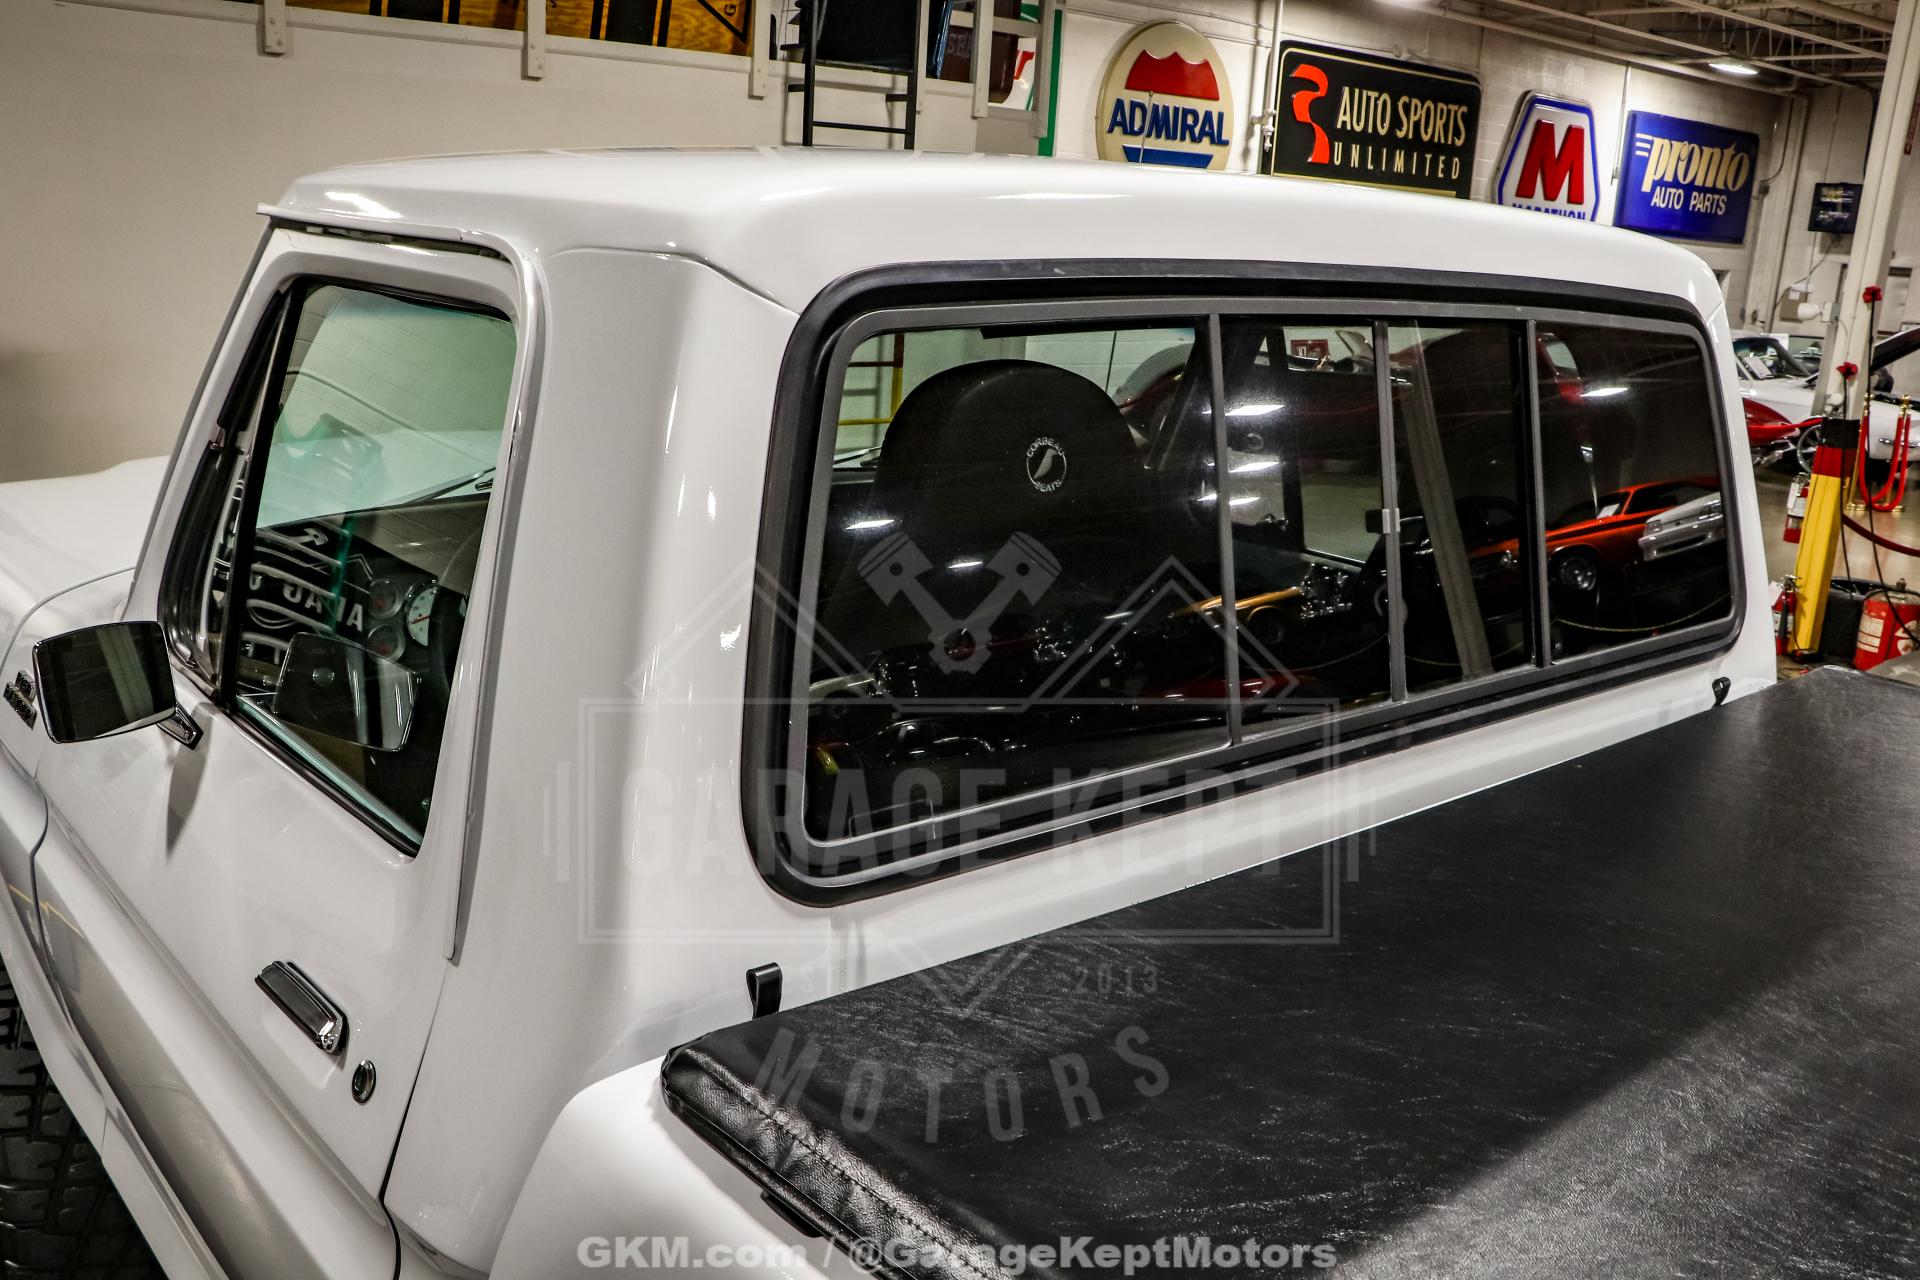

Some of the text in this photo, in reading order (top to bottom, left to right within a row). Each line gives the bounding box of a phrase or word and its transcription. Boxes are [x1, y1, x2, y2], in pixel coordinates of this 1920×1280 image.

[1107, 98, 1230, 146] ADMIRAL
[1336, 86, 1468, 146] AUTO SPORTS
[1333, 141, 1460, 180] UNLIMITED
[1515, 119, 1584, 205] M
[1641, 136, 1750, 192] pronto
[1650, 186, 1727, 215] AUTO PARTS
[1026, 436, 1065, 458] CORBEAU
[1034, 479, 1062, 492] SEATS
